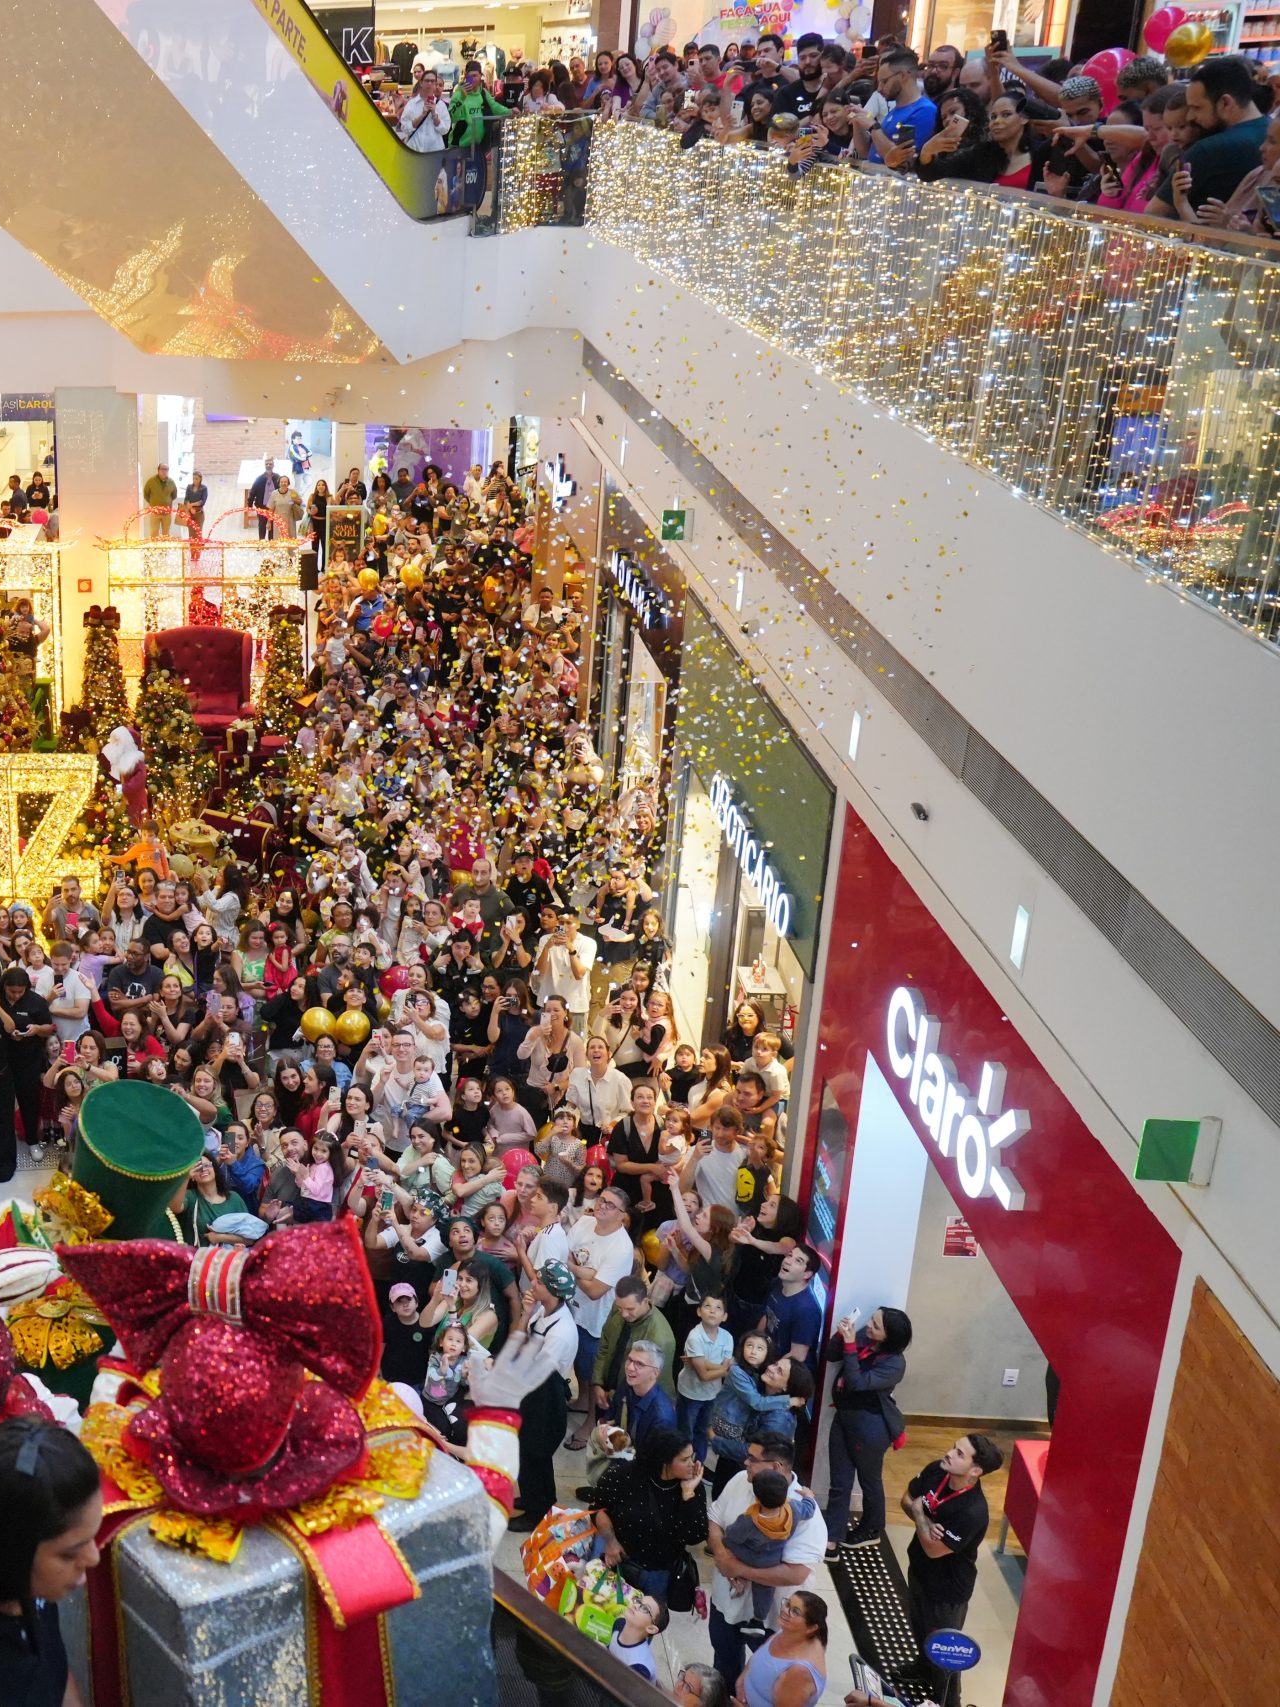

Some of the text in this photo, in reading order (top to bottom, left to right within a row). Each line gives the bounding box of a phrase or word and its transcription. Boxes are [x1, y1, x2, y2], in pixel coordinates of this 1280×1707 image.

[720, 6, 754, 19] FAÇA
[761, 12, 791, 25] AQUI
[19, 400, 55, 409] CAROL
[887, 986, 986, 1199] Claro
[931, 1643, 973, 1654] PanVel
